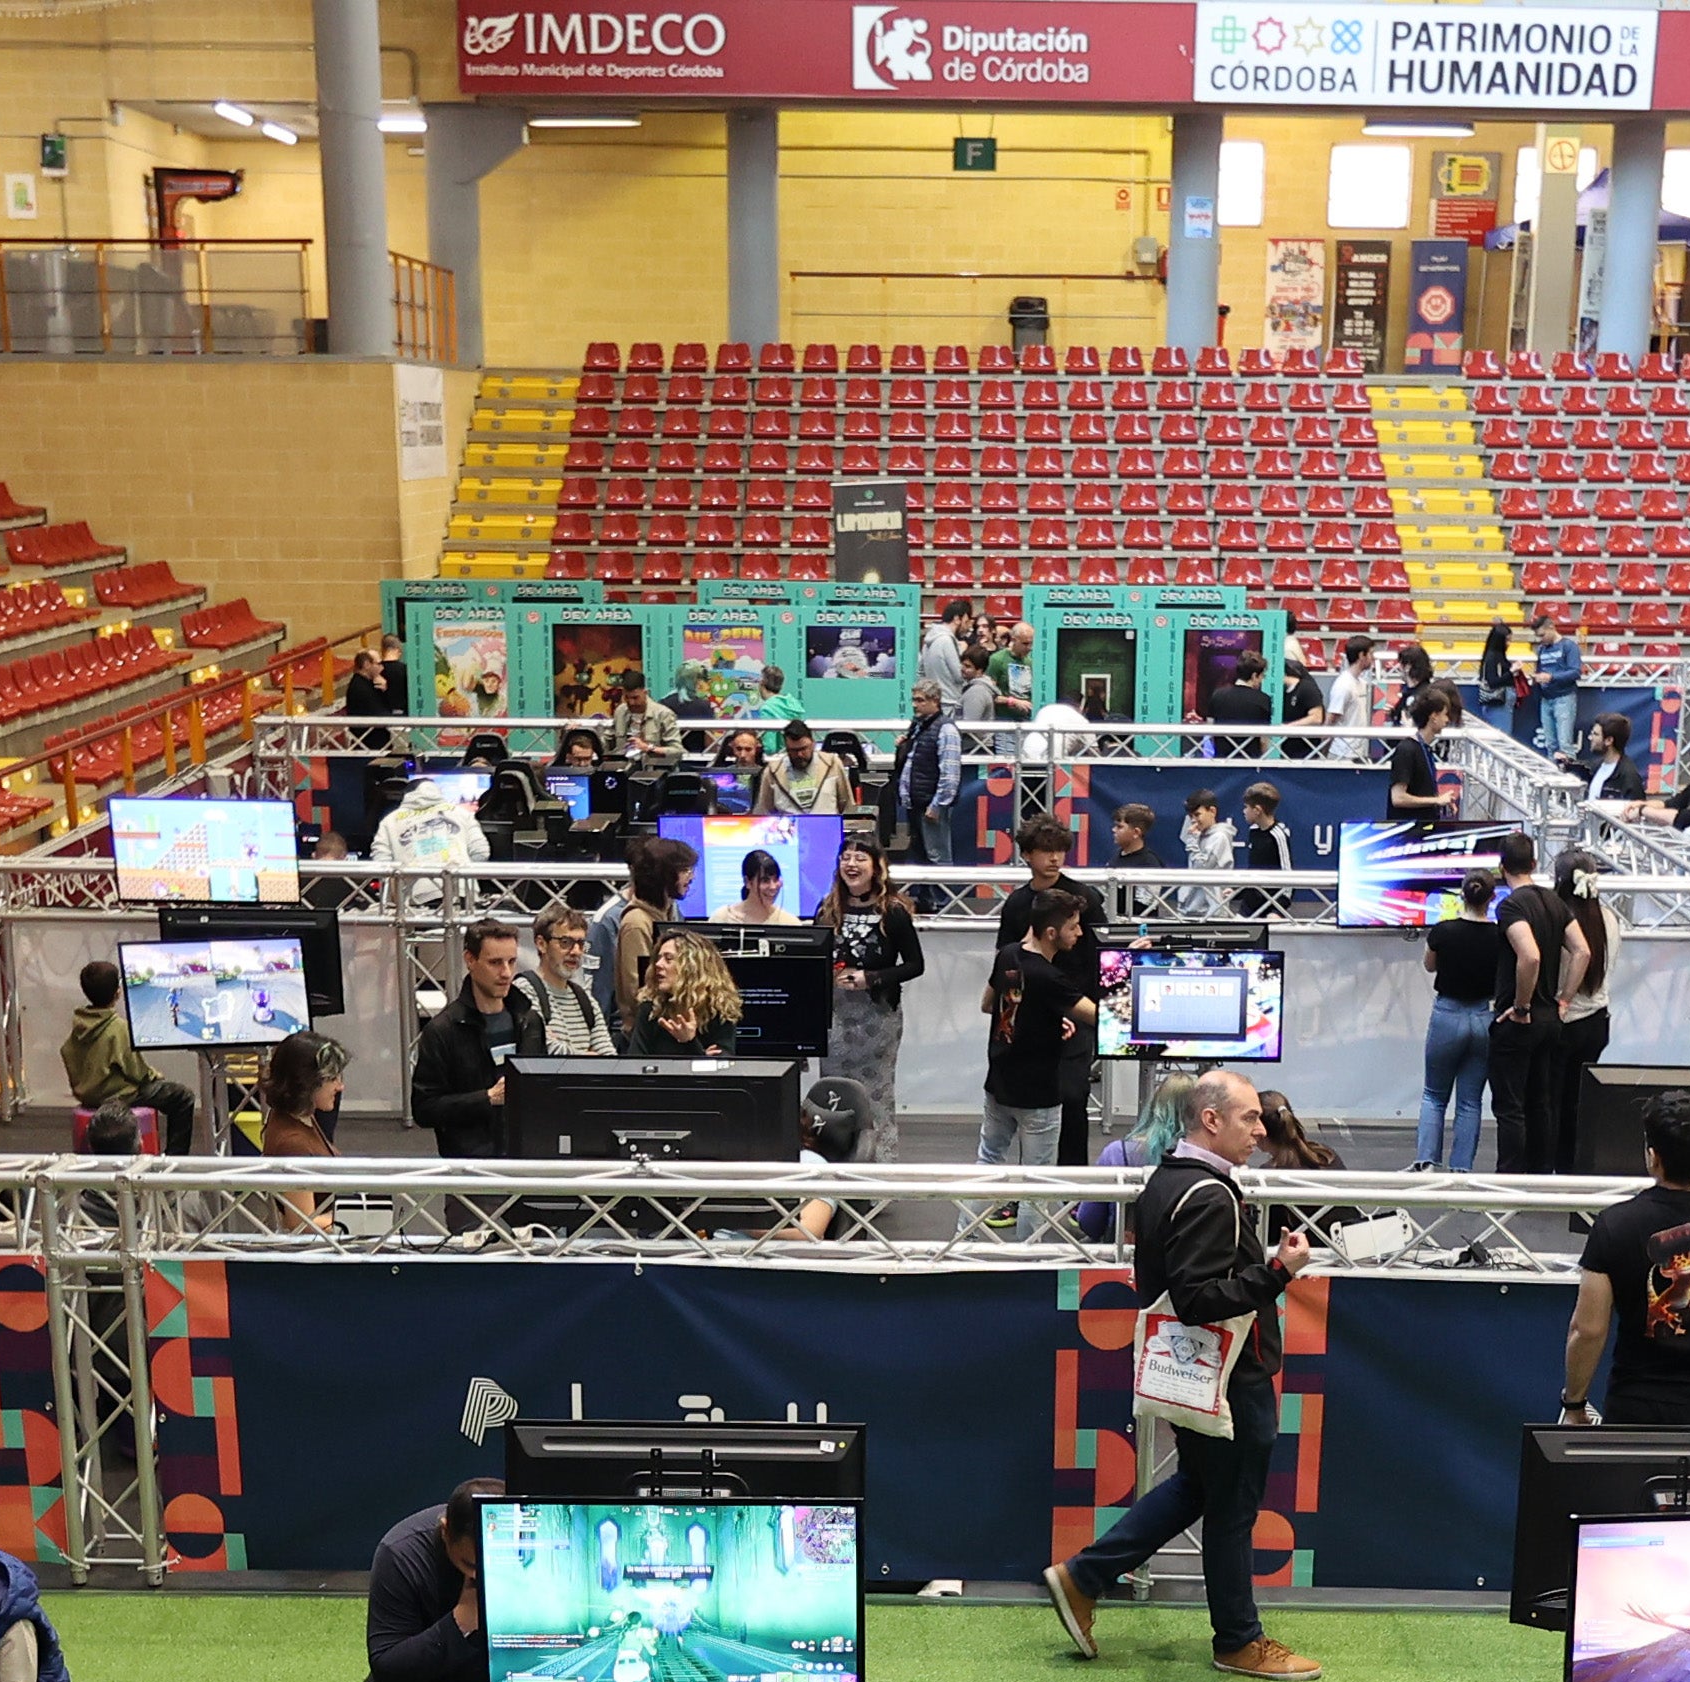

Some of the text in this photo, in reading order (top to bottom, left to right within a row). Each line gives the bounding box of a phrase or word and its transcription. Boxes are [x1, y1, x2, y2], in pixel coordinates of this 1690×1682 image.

[523, 12, 727, 57] IMDECO
[942, 24, 1088, 57] Diputación
[1390, 21, 1613, 56] PATRIMONIO
[1619, 26, 1641, 41] DE
[1618, 43, 1640, 58] LA
[466, 63, 724, 79] Instituto Municipal de Deportes Córdoba
[942, 56, 1089, 82] de Córdoba
[1210, 61, 1358, 94] CÓRDOBA
[1388, 60, 1639, 98] HUMANIDAD
[966, 142, 985, 167] F
[1147, 1359, 1214, 1385] Budweiser
